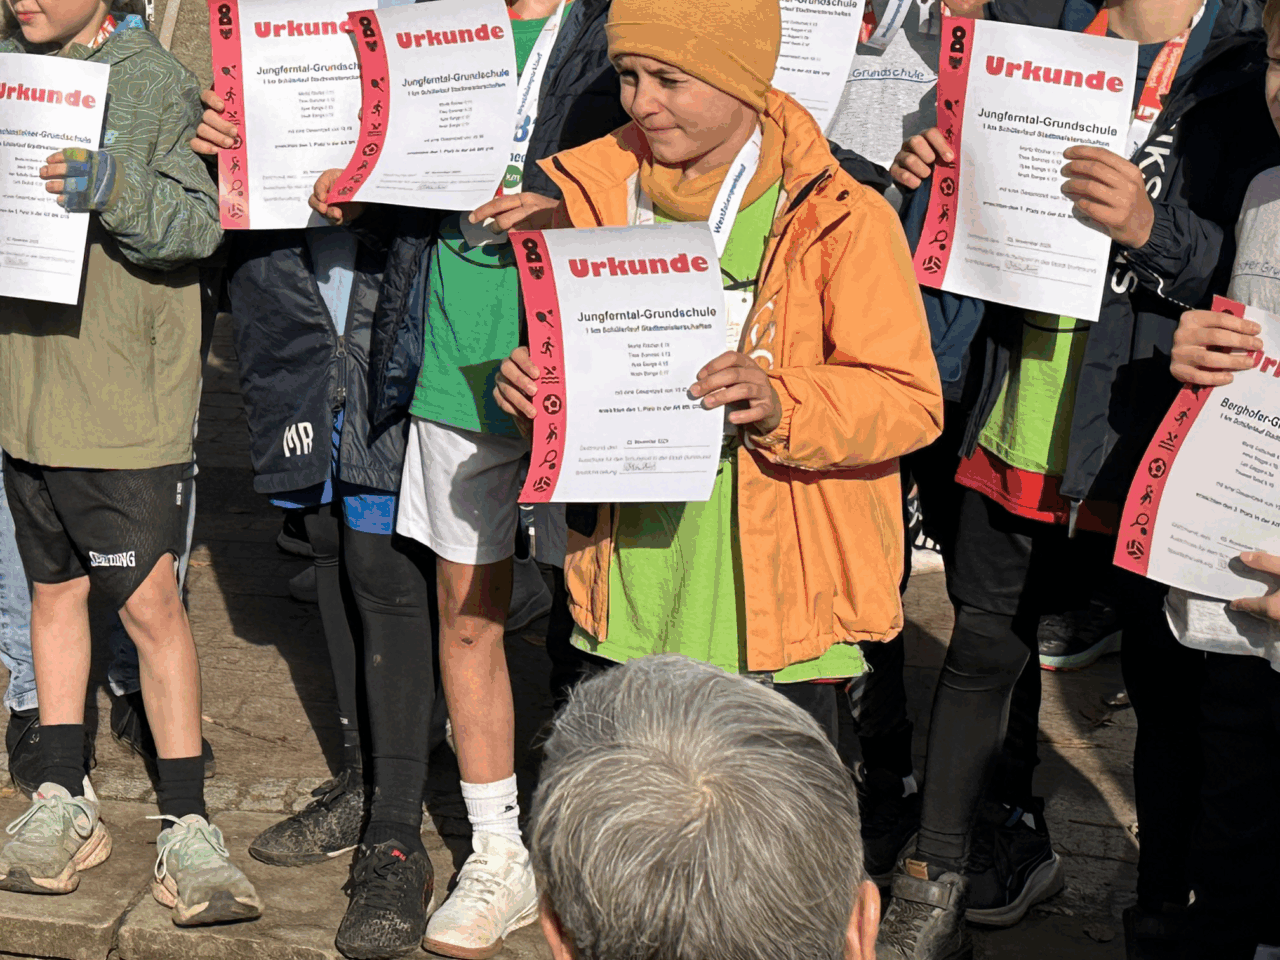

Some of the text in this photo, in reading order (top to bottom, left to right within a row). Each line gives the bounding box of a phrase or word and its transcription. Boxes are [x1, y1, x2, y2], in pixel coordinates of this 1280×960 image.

[254, 20, 354, 38] Urkund
[396, 24, 505, 49] Urkunde
[256, 62, 363, 76] Jungferntal-Grundsch
[985, 55, 1124, 93] Urkunde
[977, 108, 1117, 136] Jungferntal-Grundschule
[568, 253, 709, 278] Urkunde
[577, 307, 717, 323] Jungferntal-Grundschule
[1220, 397, 1280, 429] Berghofer-G
[283, 422, 313, 457] MR
